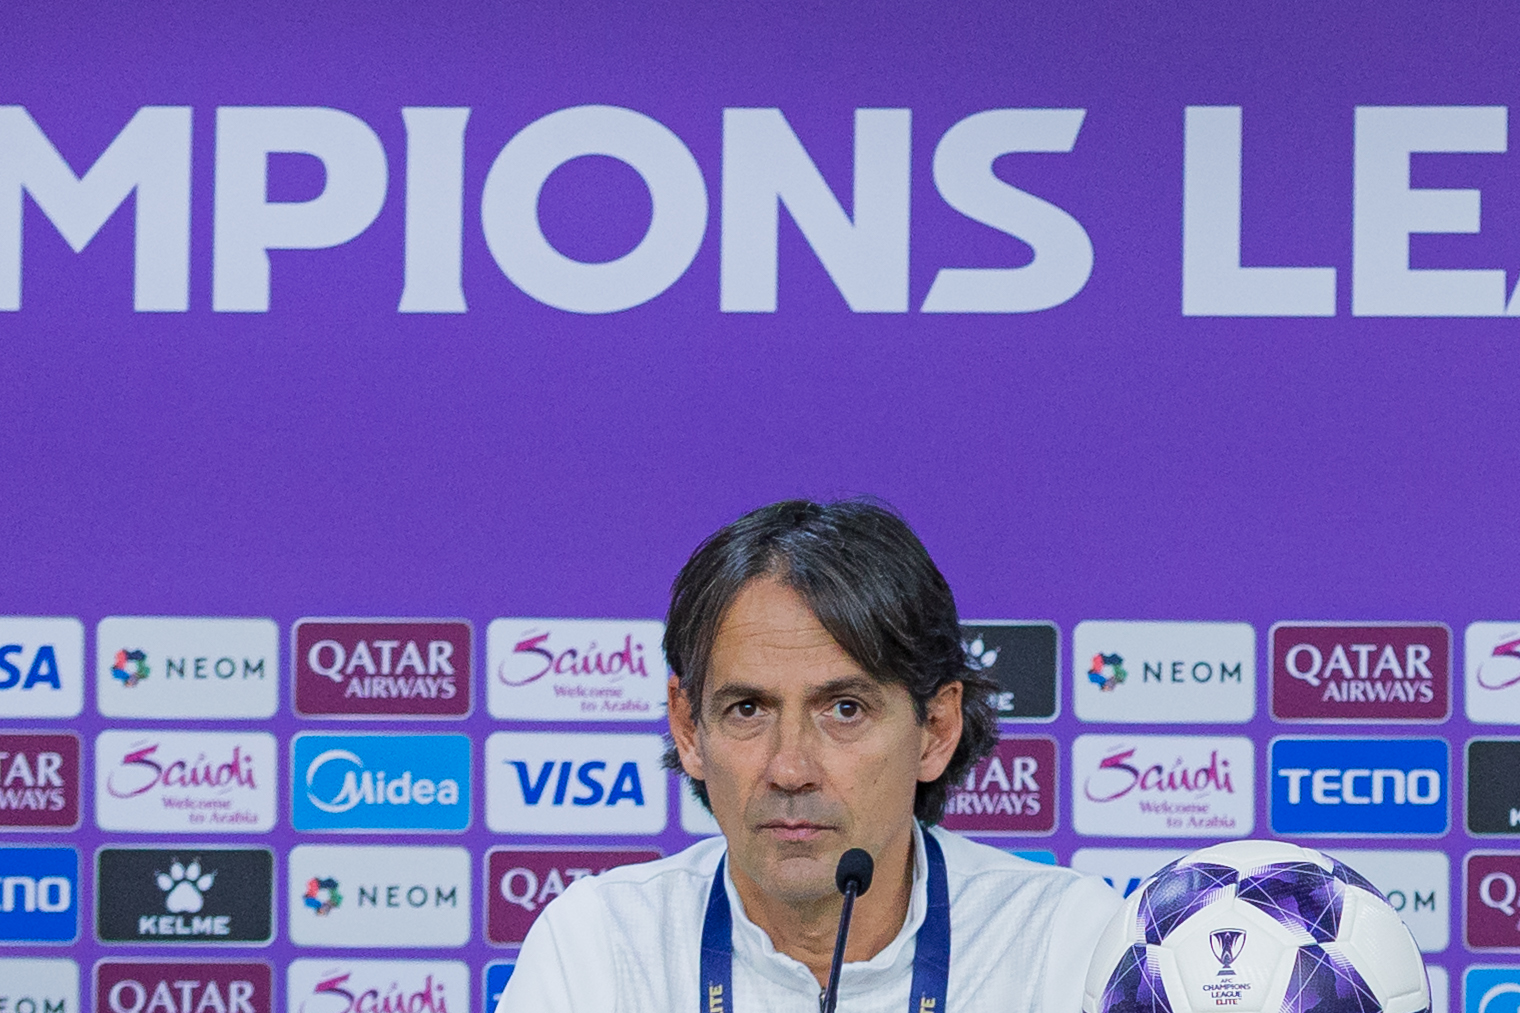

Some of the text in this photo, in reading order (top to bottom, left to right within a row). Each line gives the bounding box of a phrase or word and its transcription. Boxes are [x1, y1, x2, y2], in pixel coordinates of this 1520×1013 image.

[166, 658, 266, 681] NEOM
[308, 639, 456, 683] QATAR
[1142, 661, 1243, 683] NEOM
[1285, 642, 1433, 688] QATAR
[344, 675, 457, 700] AIRWAYS
[1321, 680, 1434, 703] AIRWAYS
[323, 768, 459, 813] Midea
[503, 760, 646, 807] VISA
[1278, 768, 1441, 805] TECNO
[357, 885, 457, 908] NEOM
[138, 915, 231, 936] KELME
